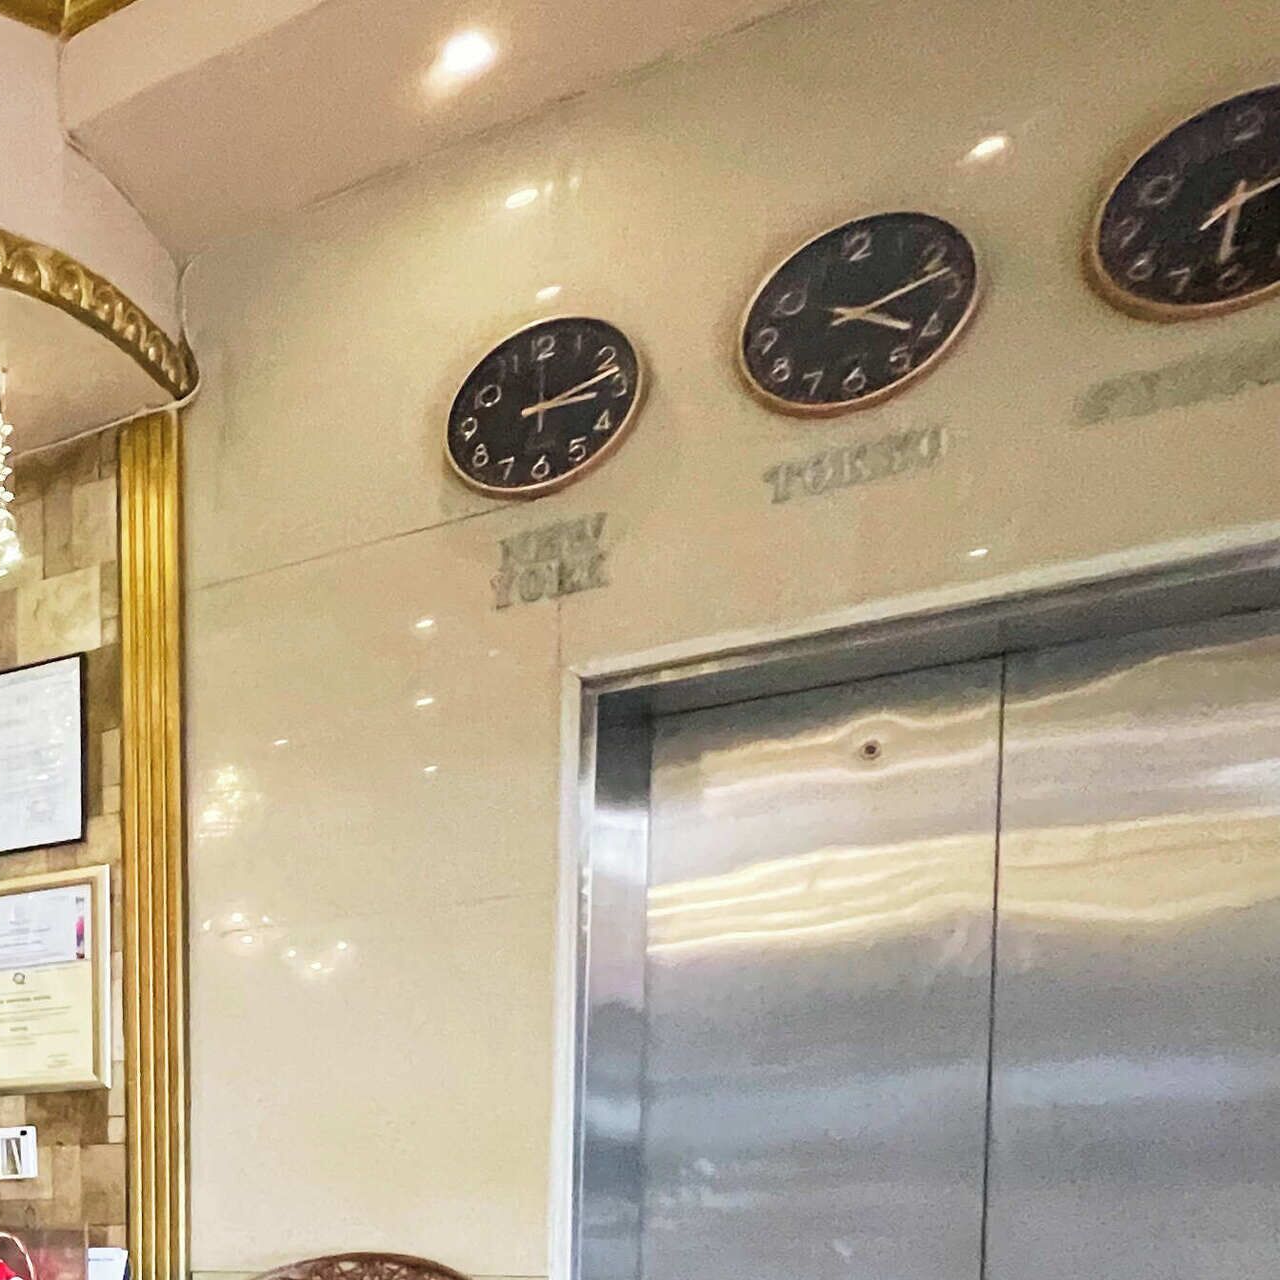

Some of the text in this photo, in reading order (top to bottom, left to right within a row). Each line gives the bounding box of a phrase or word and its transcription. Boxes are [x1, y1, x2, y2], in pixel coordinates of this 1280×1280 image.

[531, 334, 556, 361] 12
[597, 346, 617, 372] 2
[460, 416, 479, 442] 9
[592, 408, 612, 431] 4
[472, 443, 489, 468] 8
[568, 436, 588, 463] 5
[498, 456, 516, 481] 7
[530, 455, 551, 481] 6
